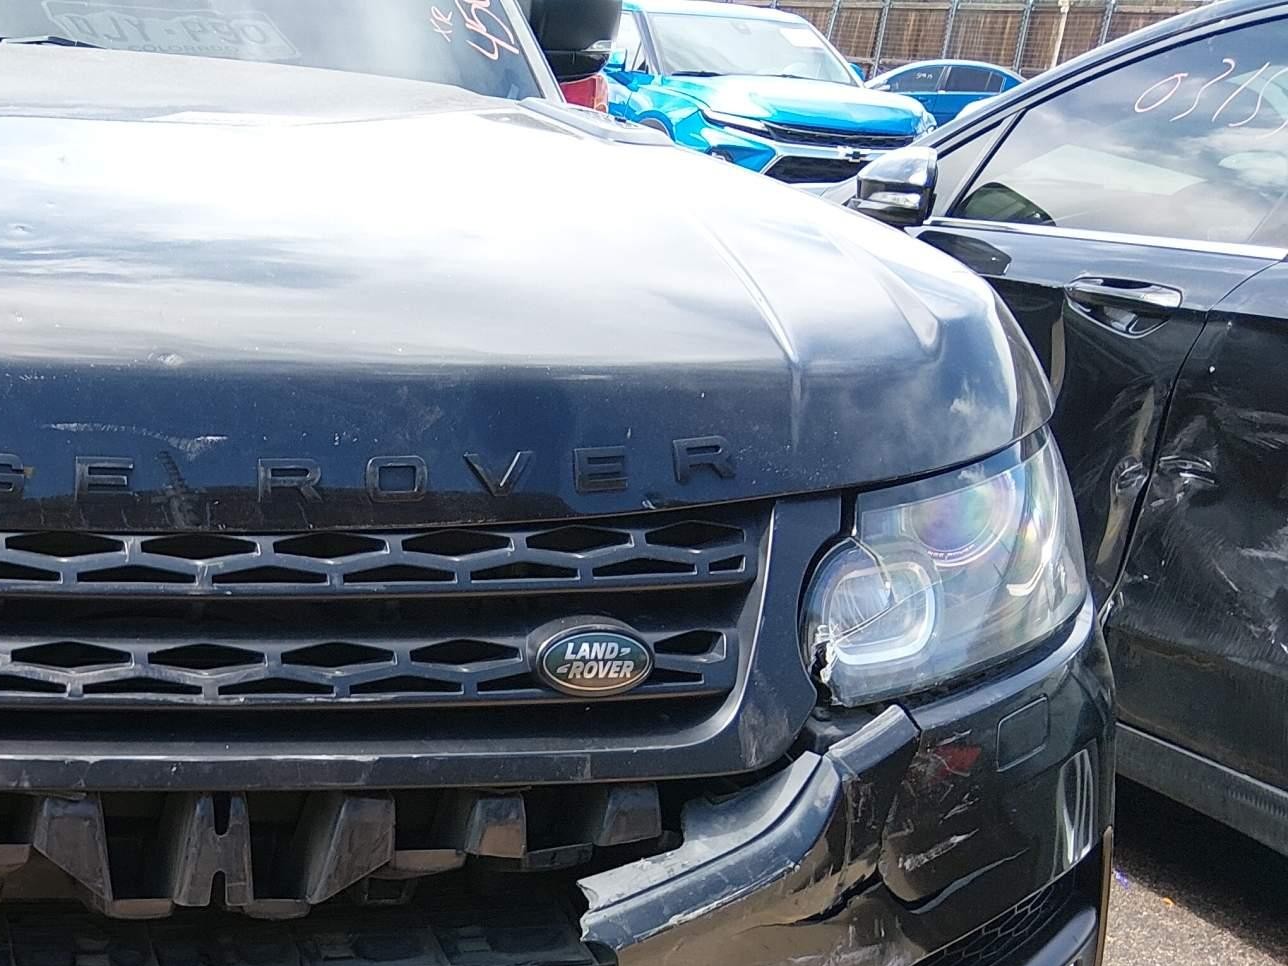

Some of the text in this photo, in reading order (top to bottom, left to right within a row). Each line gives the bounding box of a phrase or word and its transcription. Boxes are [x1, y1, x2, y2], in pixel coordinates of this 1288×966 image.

[256, 433, 737, 503] ROVER
[564, 642, 620, 660] LAND
[567, 660, 635, 679] ROVER
